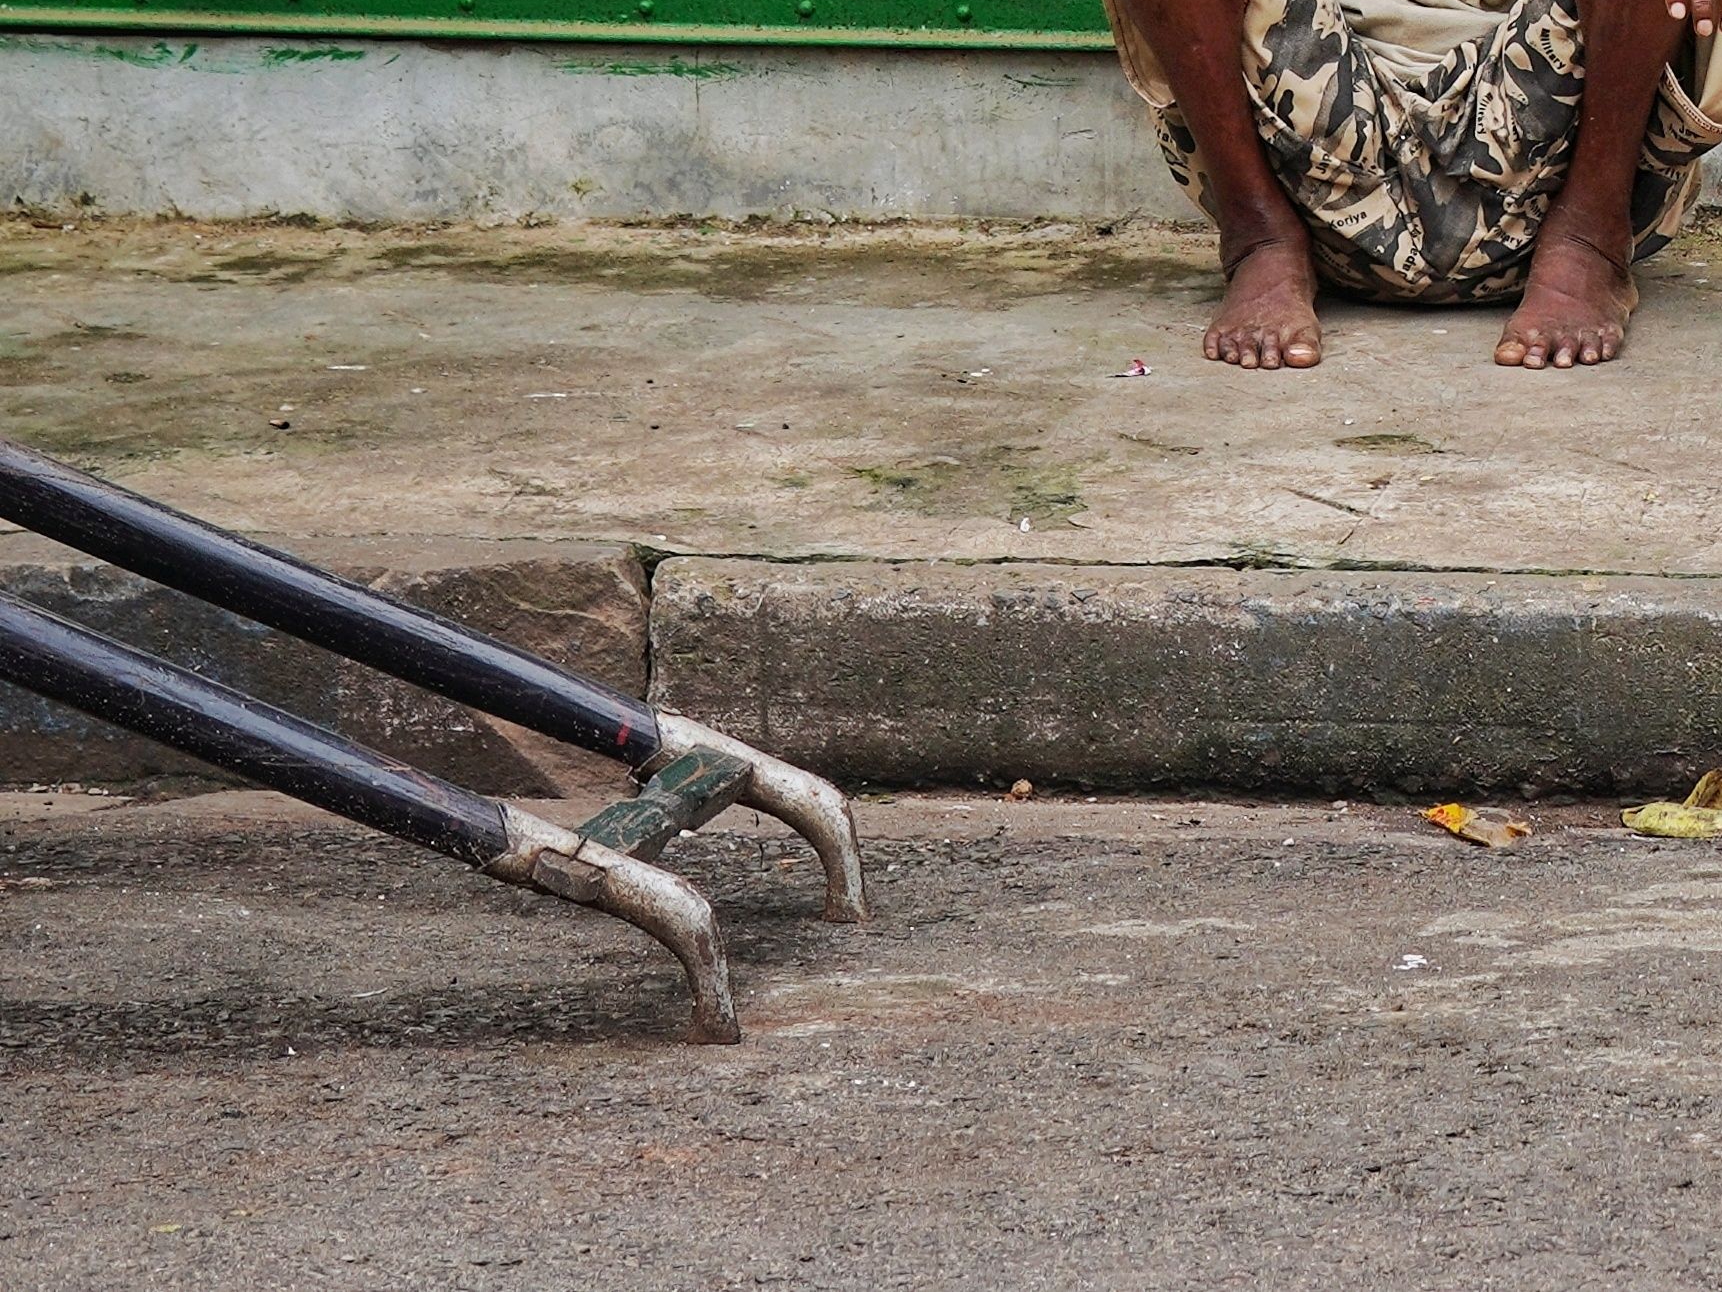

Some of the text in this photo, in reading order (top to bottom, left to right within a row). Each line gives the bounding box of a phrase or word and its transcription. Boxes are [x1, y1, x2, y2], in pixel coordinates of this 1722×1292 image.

[1540, 27, 1566, 70] Military
[1477, 92, 1494, 135] Military
[1401, 246, 1418, 279] Japa
